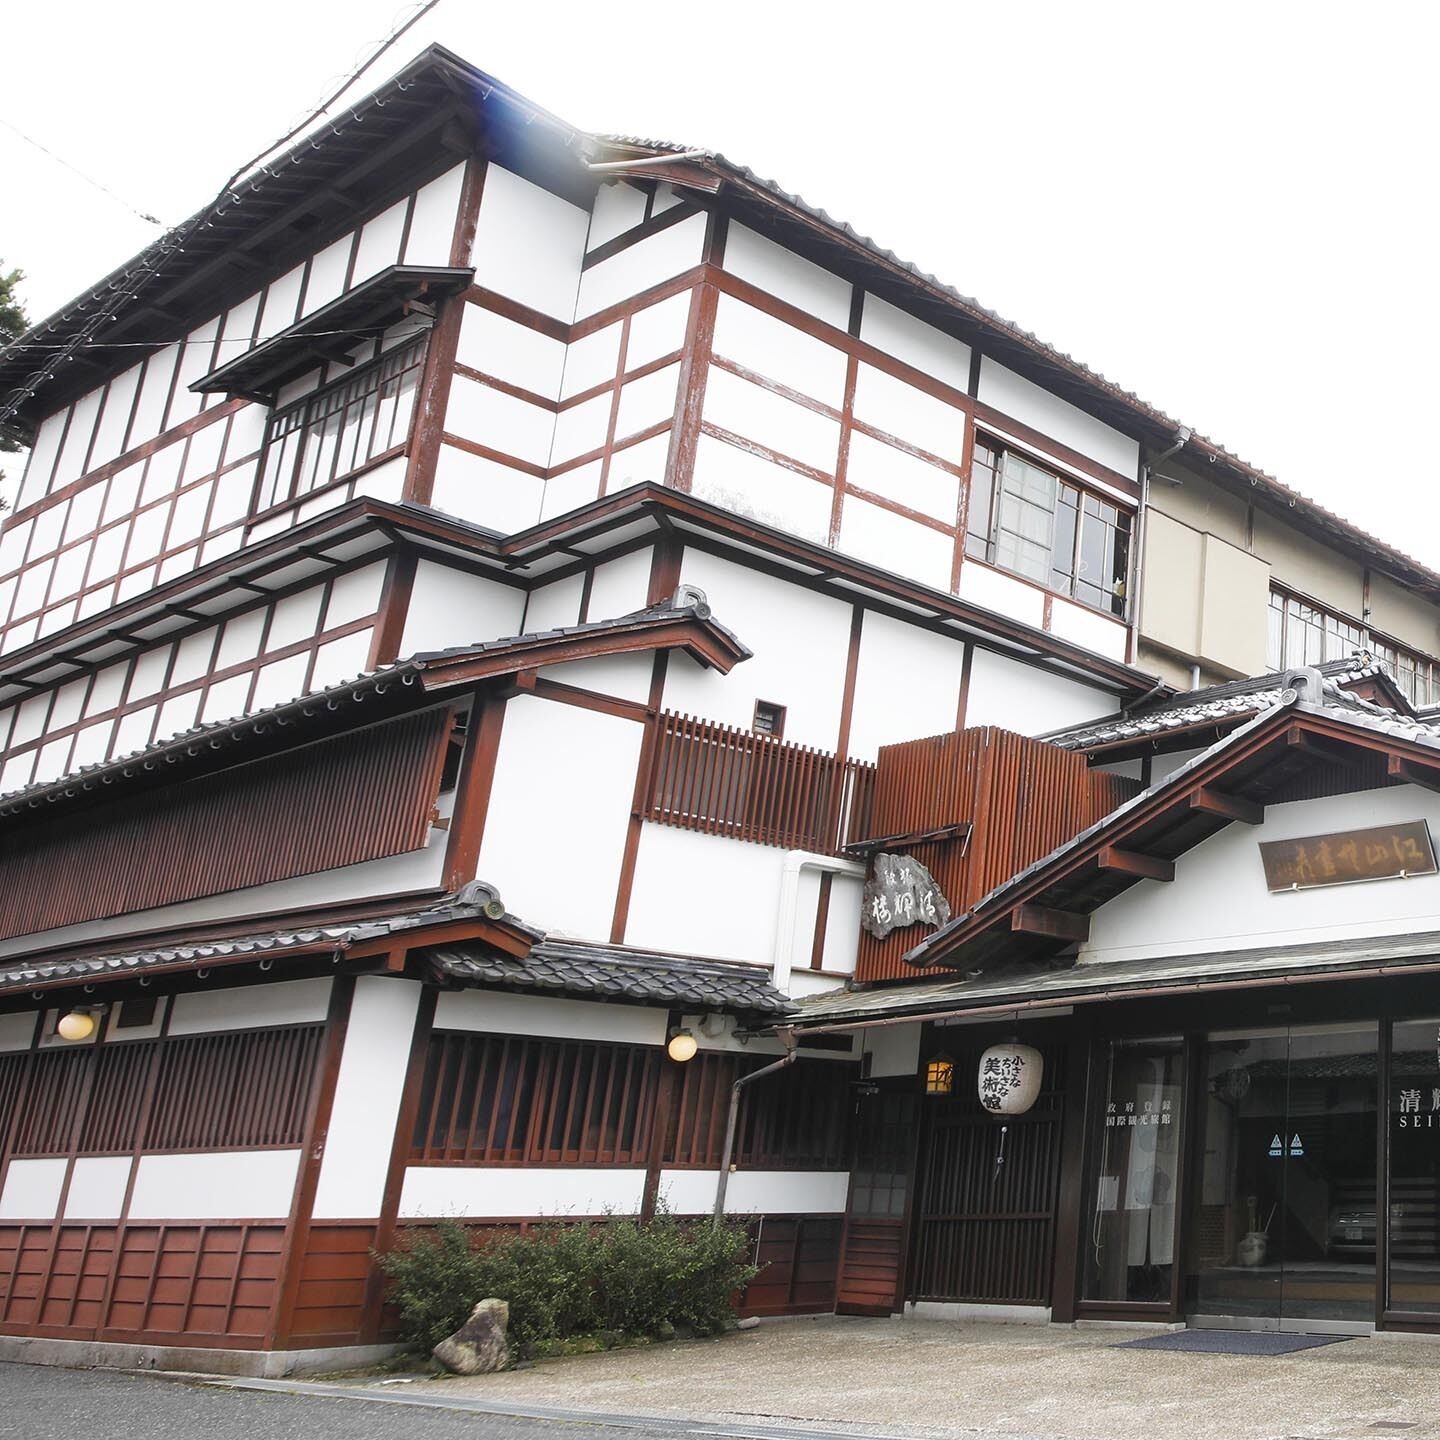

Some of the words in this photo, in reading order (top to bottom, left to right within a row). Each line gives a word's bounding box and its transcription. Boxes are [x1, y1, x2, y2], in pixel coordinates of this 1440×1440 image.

[997, 1057, 1011, 1097] ちいさな
[1009, 1055, 1026, 1088] 小さな
